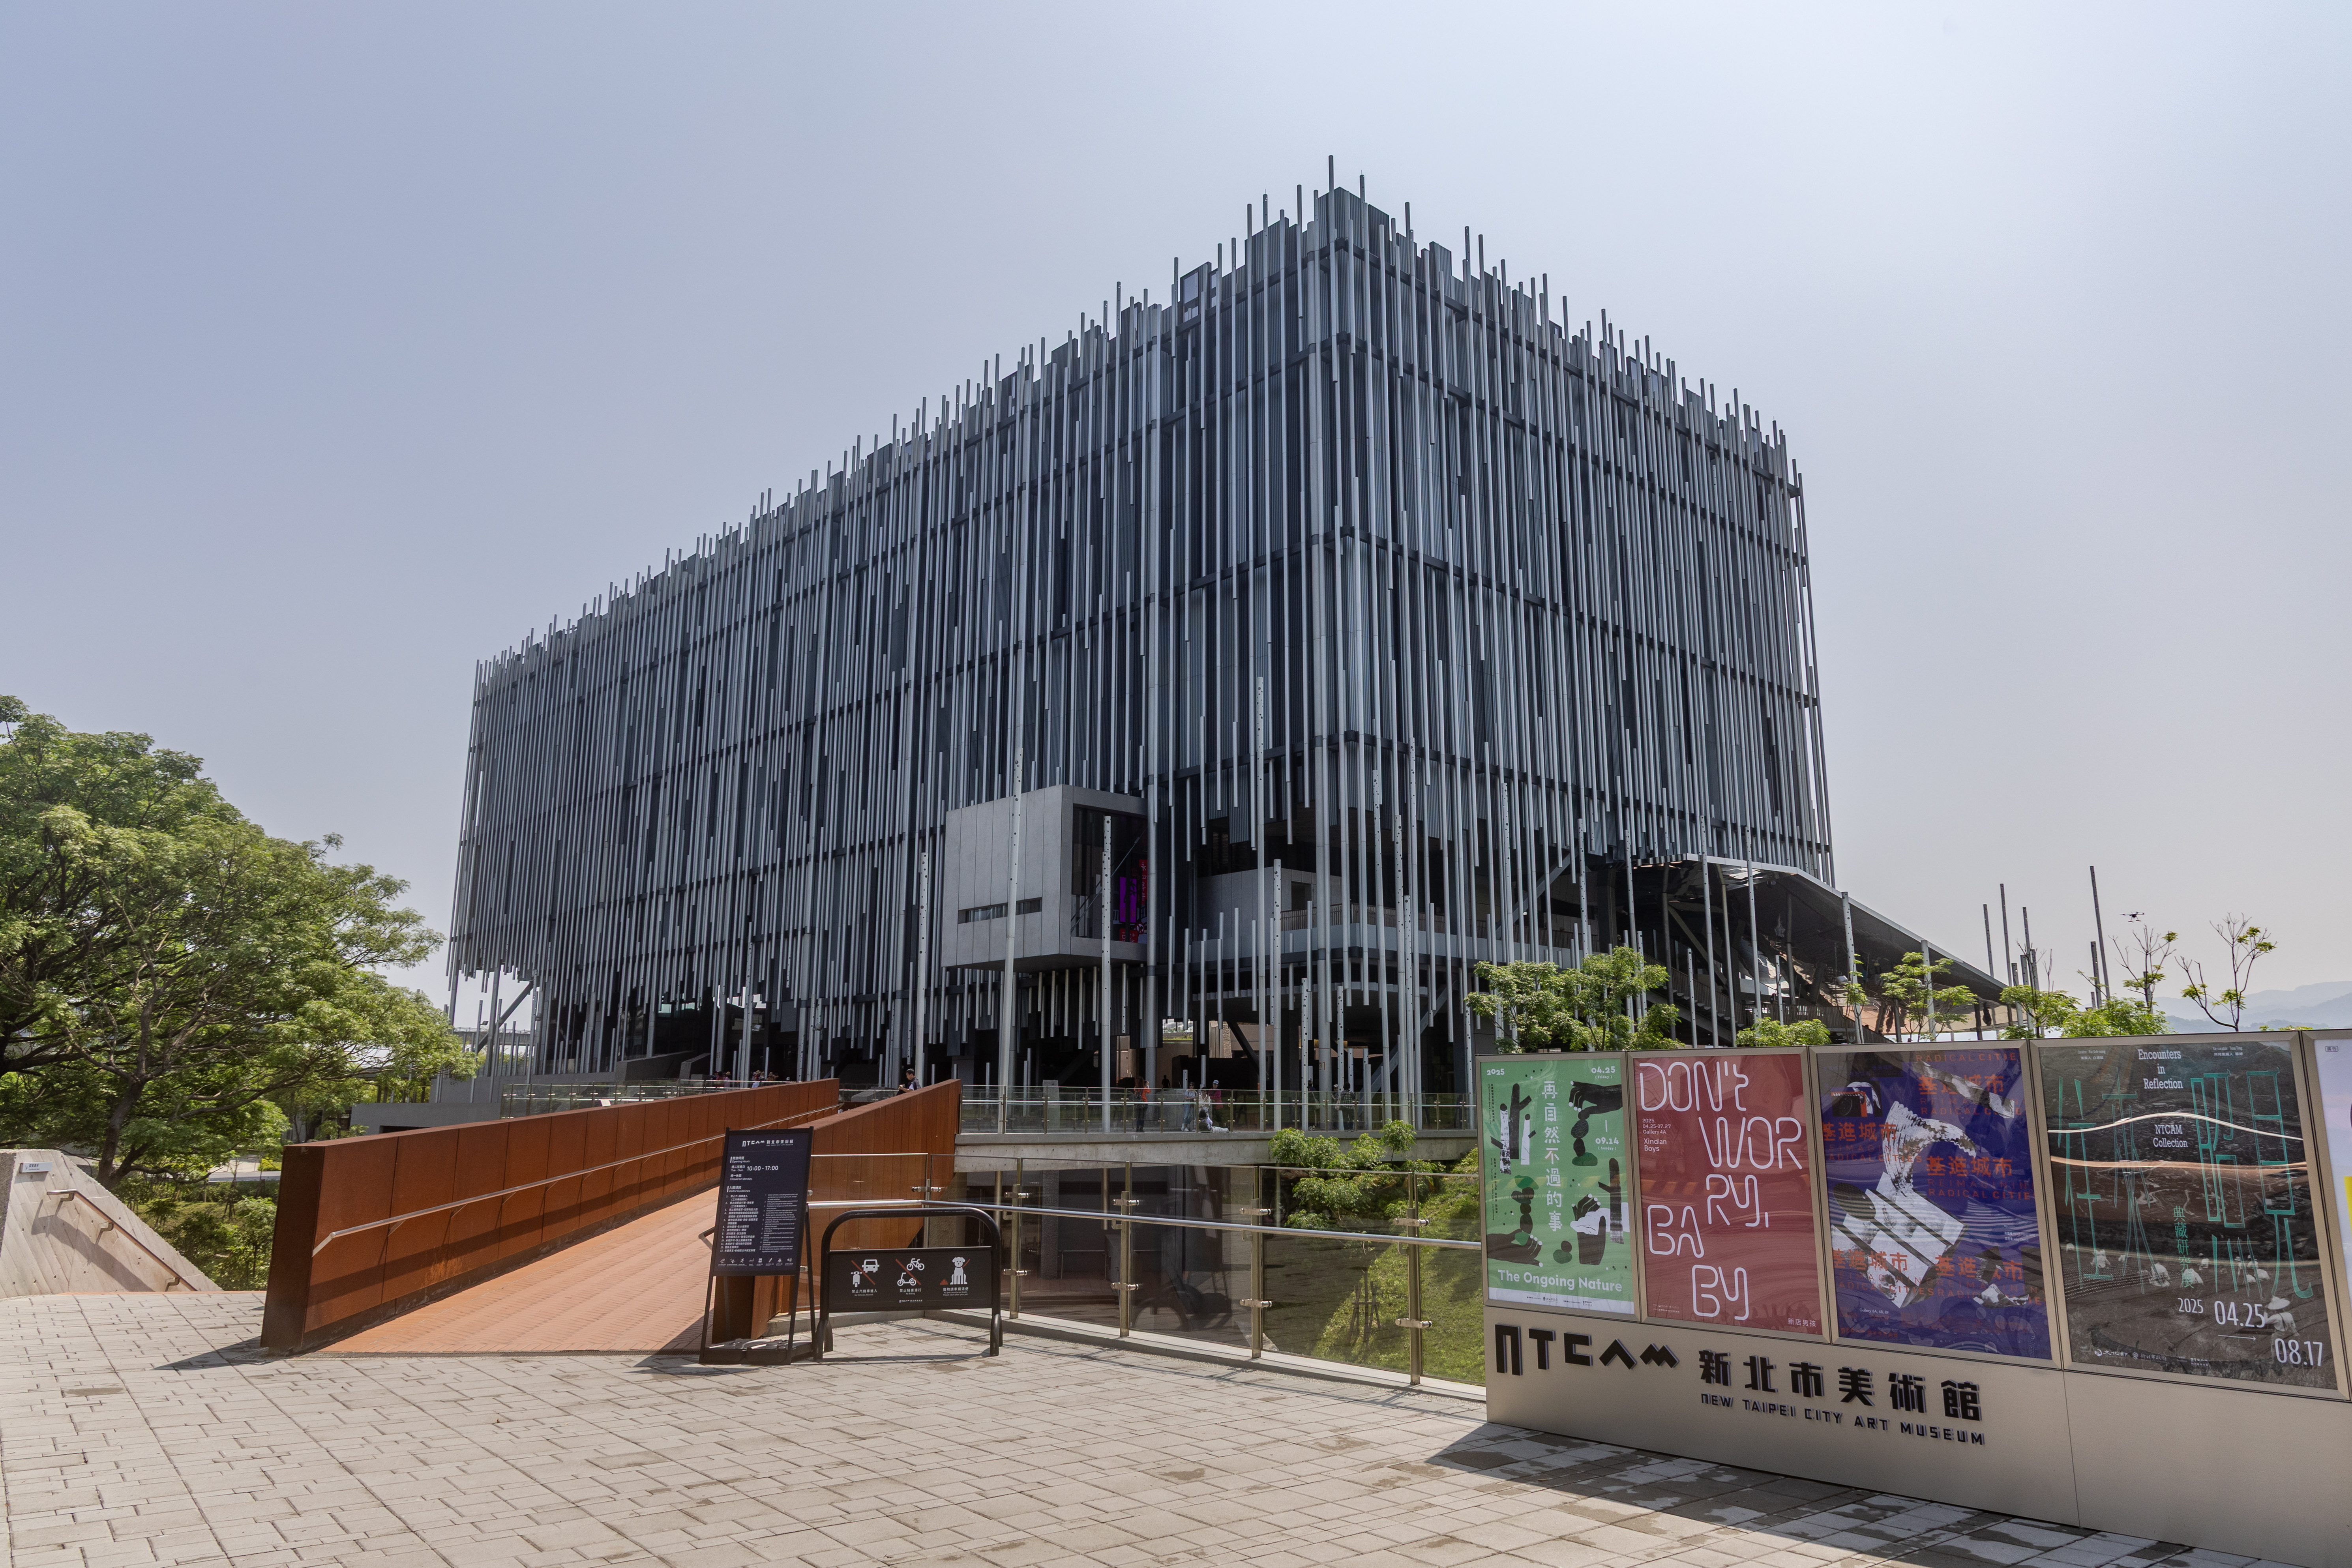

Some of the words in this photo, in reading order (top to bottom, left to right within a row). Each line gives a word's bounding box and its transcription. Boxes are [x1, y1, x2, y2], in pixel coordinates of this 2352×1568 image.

[2138, 1049, 2182, 1060] Encounters
[2157, 1064, 2166, 1075] in
[2143, 1078, 2183, 1090] Reflection
[2154, 1124, 2183, 1135] NTCAM
[1698, 1117, 1802, 1169] WOR
[2153, 1137, 2189, 1148] Collection
[1541, 1081, 1563, 1232] 再自然不過的事
[1926, 1156, 2012, 1176] 基進城市
[1928, 1190, 1988, 1199] RADICAL
[1992, 1191, 2035, 1200] CITIE
[1647, 1205, 1704, 1258] BA
[2173, 1206, 2194, 1289] 典藏研究展
[1498, 1269, 1520, 1282] The
[1523, 1272, 1575, 1291] Ongoing
[1579, 1277, 1622, 1292] Nature
[1839, 1281, 1885, 1292] ADICAL
[1889, 1285, 1934, 1296] CITIES
[1692, 1264, 1749, 1321] BY
[2178, 1298, 2204, 1314] 2025
[2214, 1300, 2265, 1328] 04.25
[1788, 1317, 1816, 1328] 新店男孩
[2275, 1338, 2323, 1366] 08.17
[1698, 1349, 1983, 1421] 新北市美術館
[1701, 1392, 1734, 1408] NEW
[1742, 1399, 1796, 1417] TAIPEI
[1805, 1408, 1842, 1424] CITY
[1854, 1415, 1890, 1431] ART
[1900, 1422, 1985, 1445] MUSEUM
